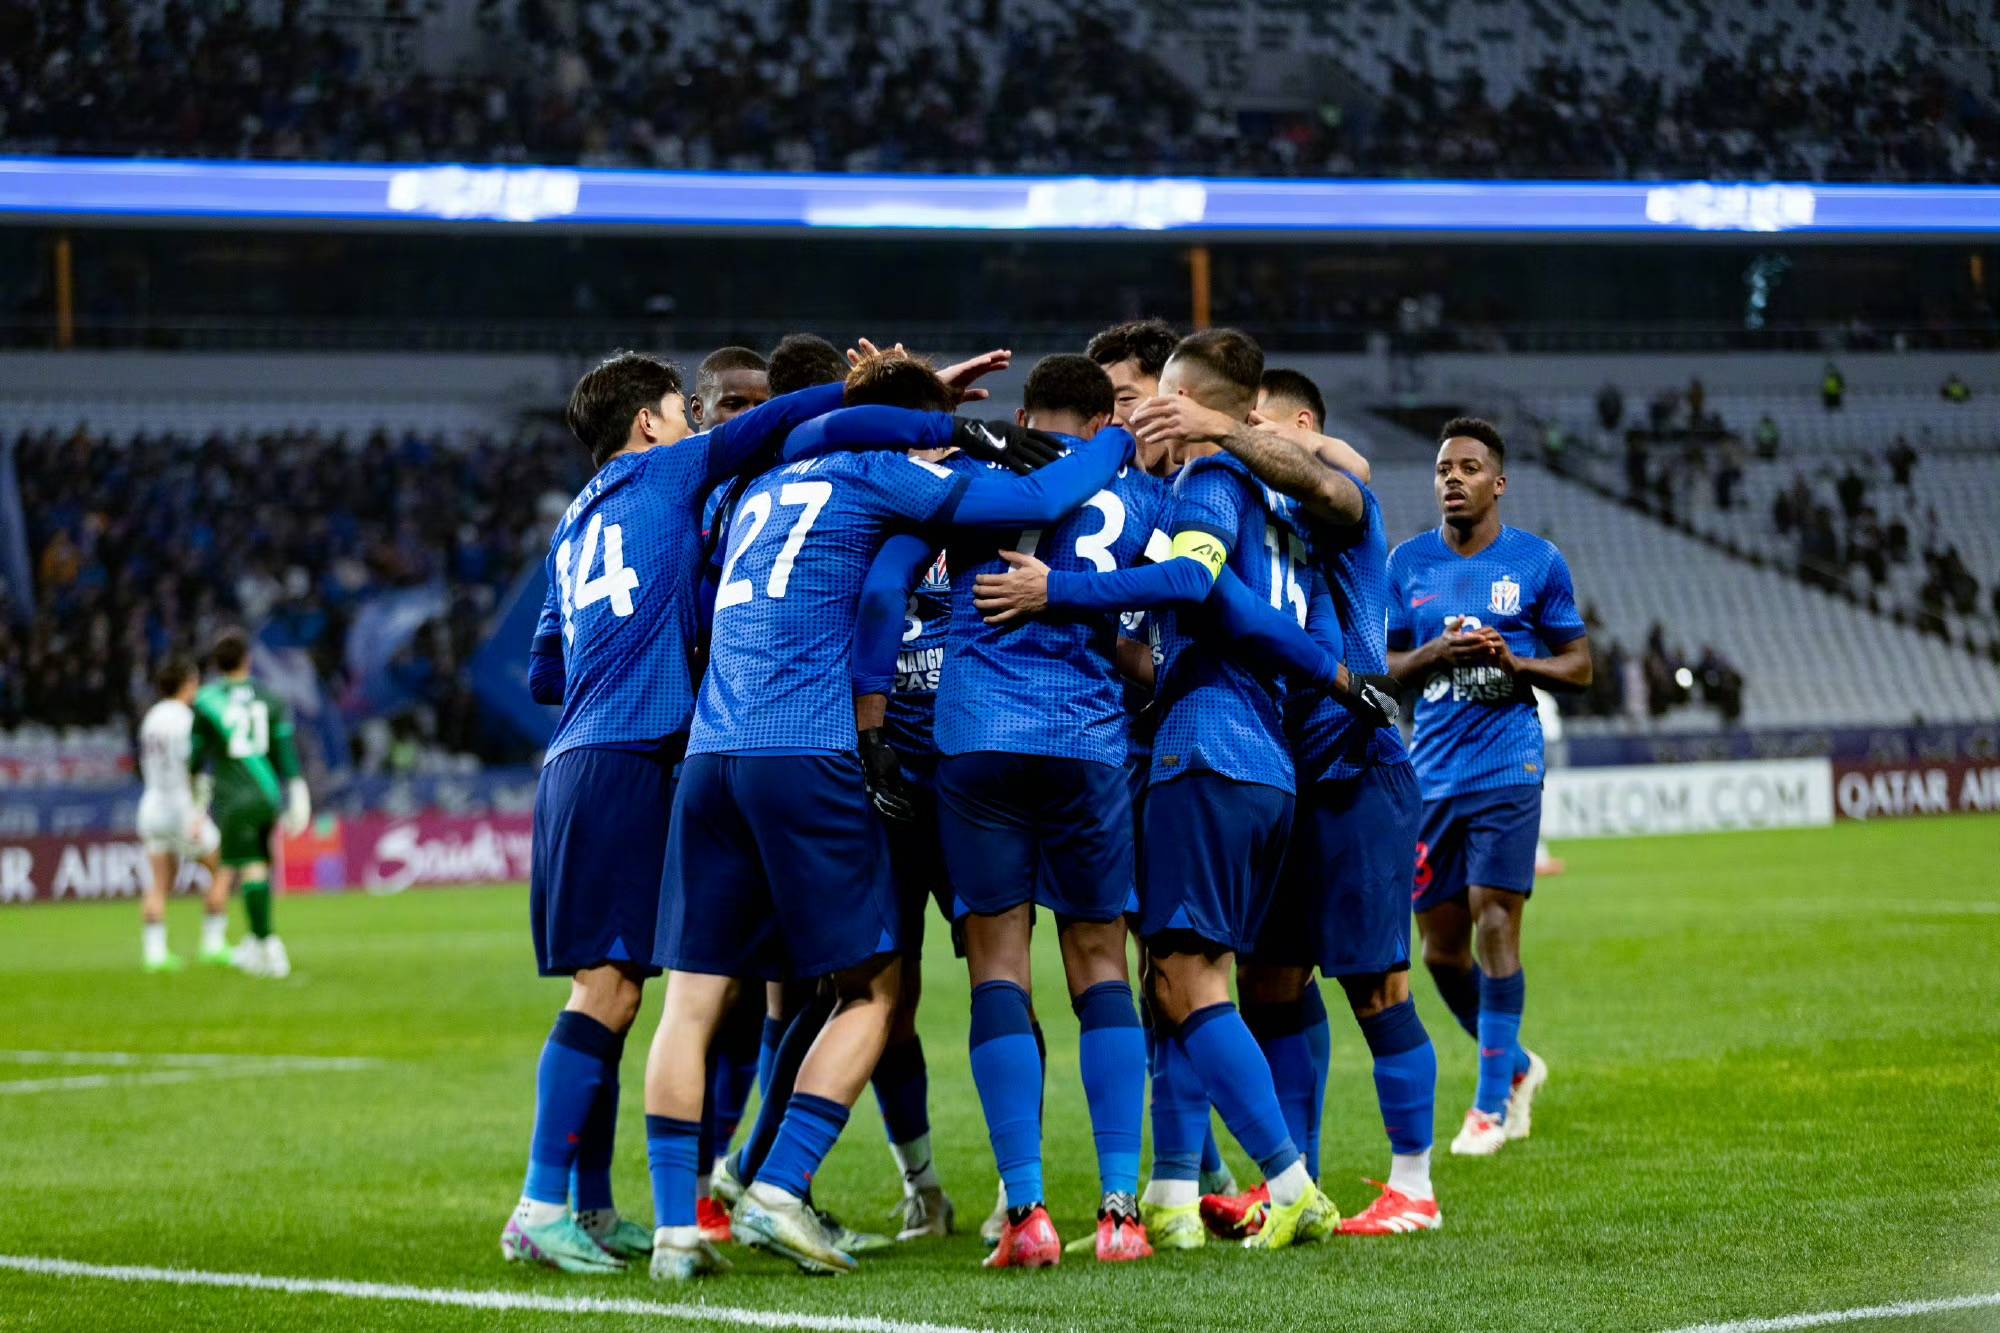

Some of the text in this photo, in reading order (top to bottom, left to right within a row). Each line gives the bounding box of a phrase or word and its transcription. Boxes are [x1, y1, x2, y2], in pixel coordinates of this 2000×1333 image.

[556, 512, 640, 647] 14
[715, 481, 833, 613] 27
[1264, 524, 1308, 630] 15
[1838, 769, 1951, 822] QATAR
